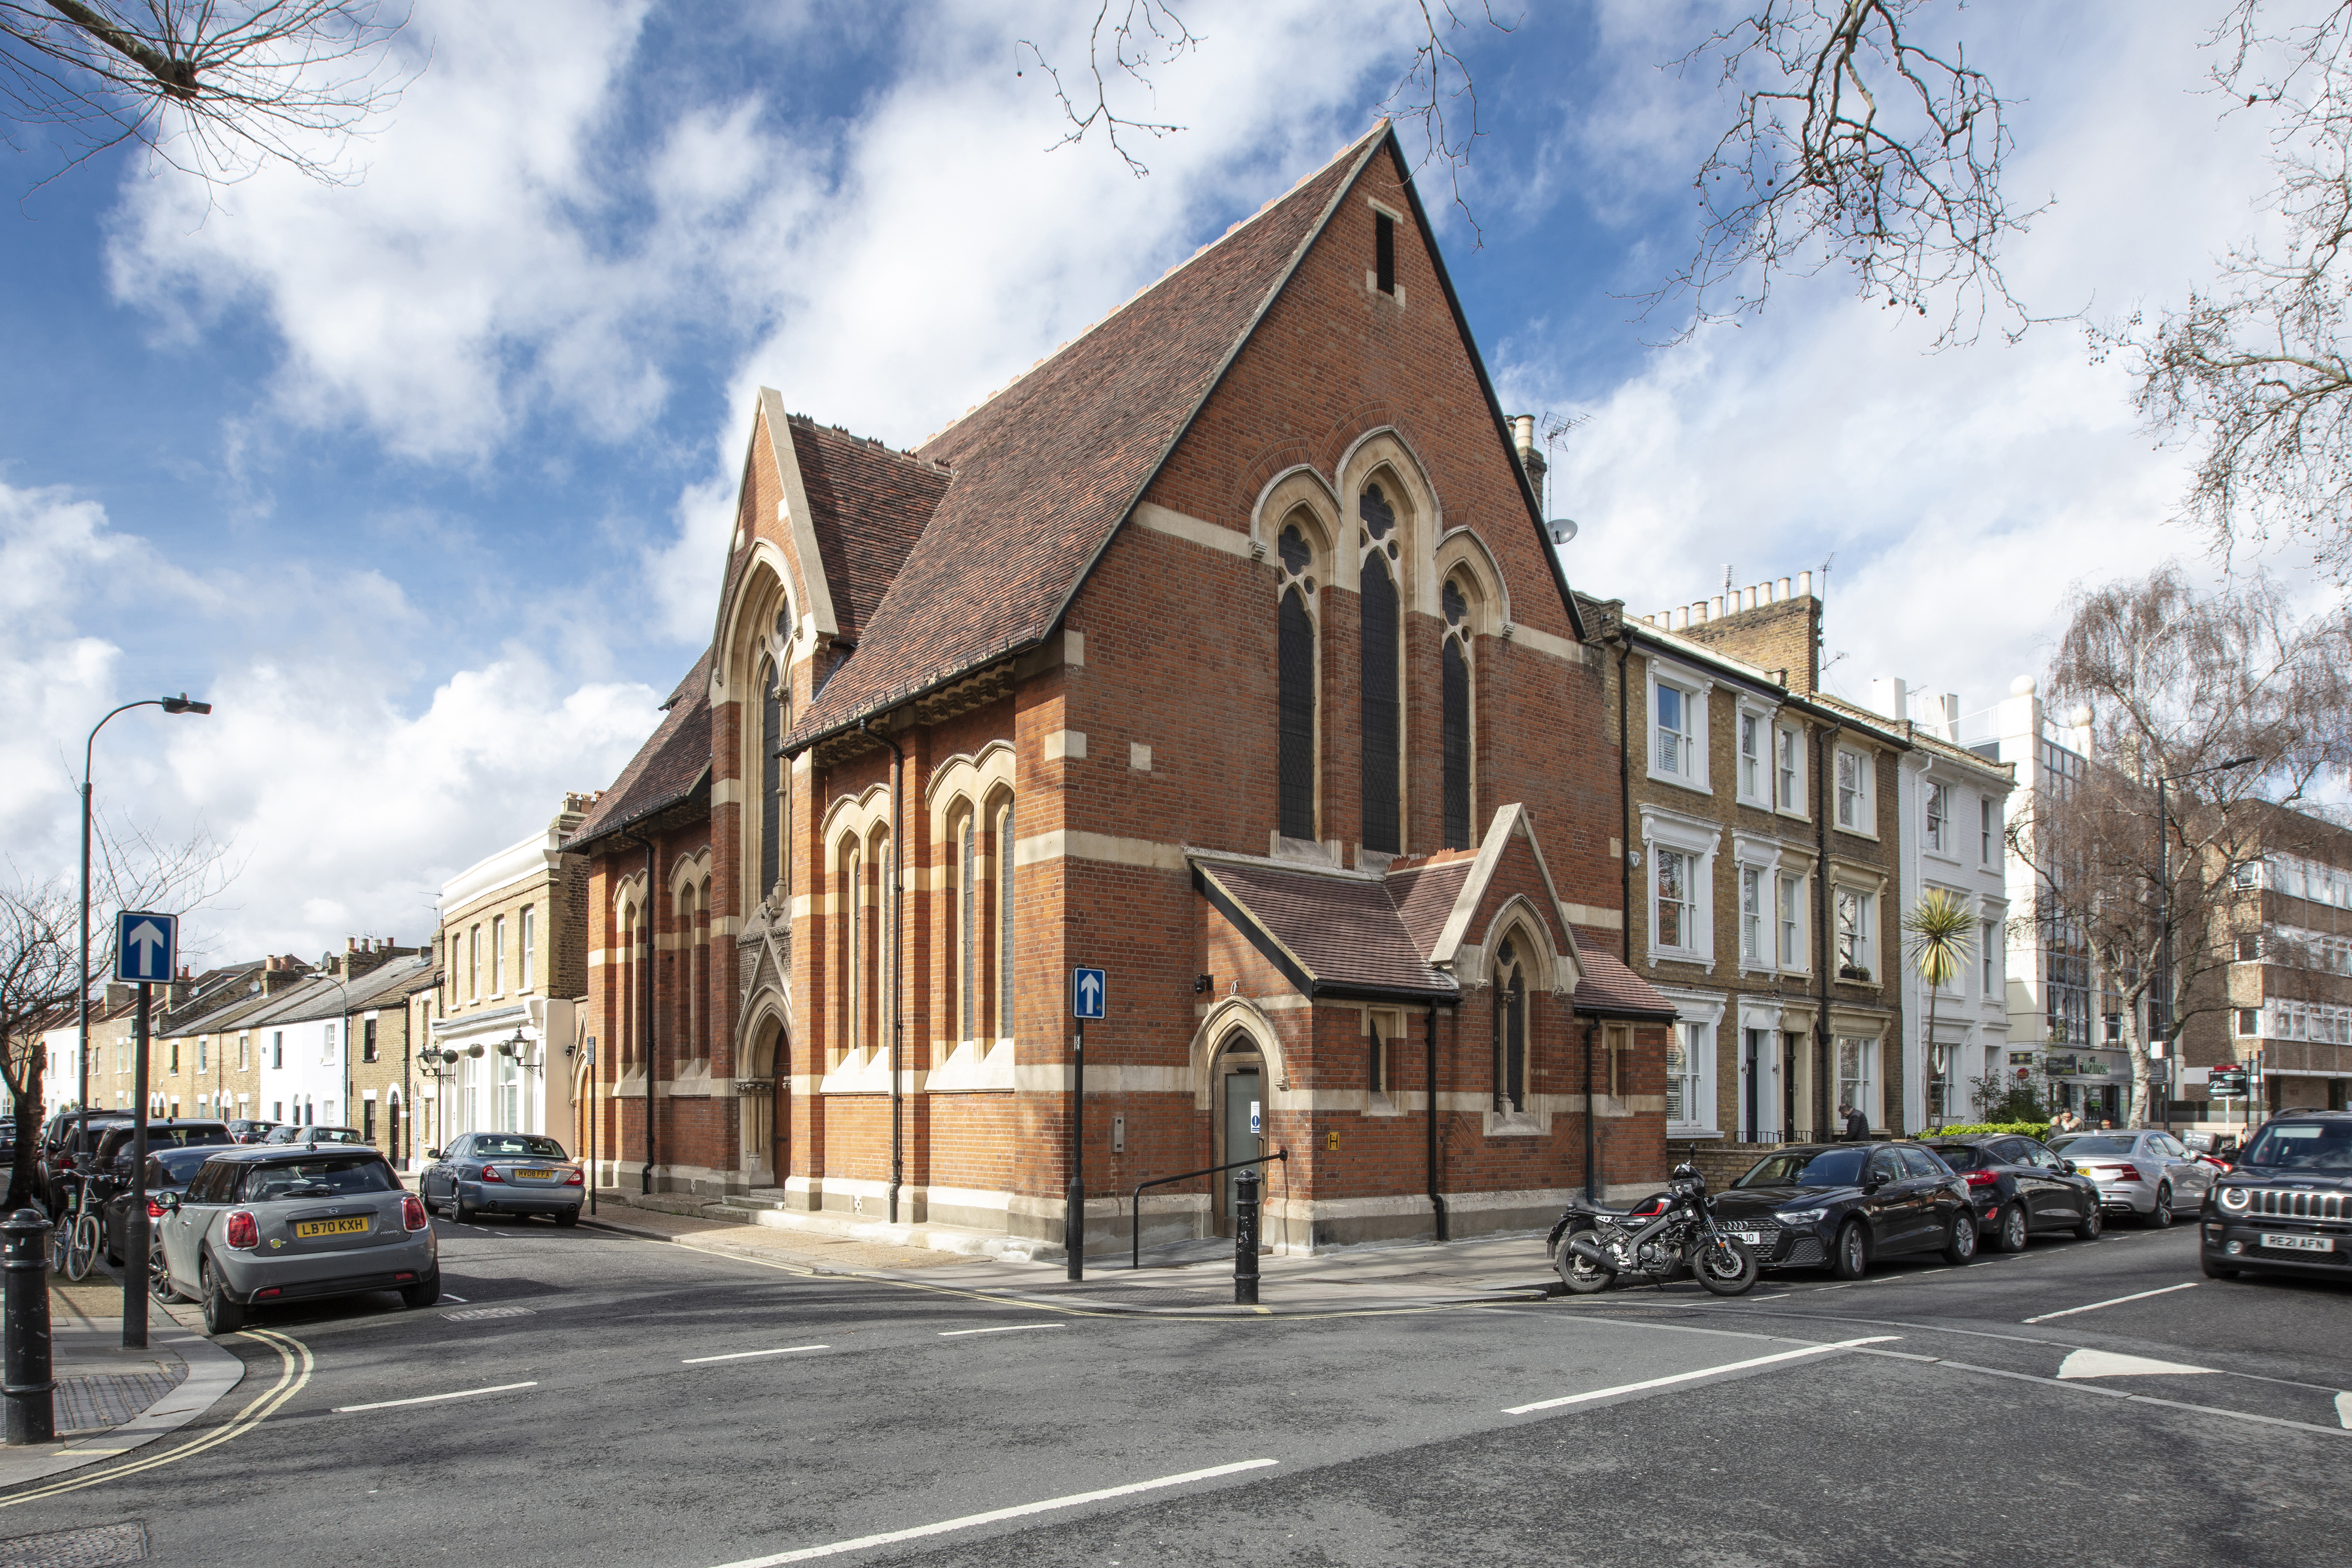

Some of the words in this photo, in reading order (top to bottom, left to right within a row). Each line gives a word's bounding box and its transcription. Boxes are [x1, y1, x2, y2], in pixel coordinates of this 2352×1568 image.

[2082, 1061, 2110, 1075] Waitrose
[1330, 1134, 1338, 1148] H
[302, 1222, 335, 1235] LB70
[339, 1219, 363, 1231] KXH
[2268, 1235, 2296, 1247] RE21
[2299, 1238, 2325, 1250] AFN
